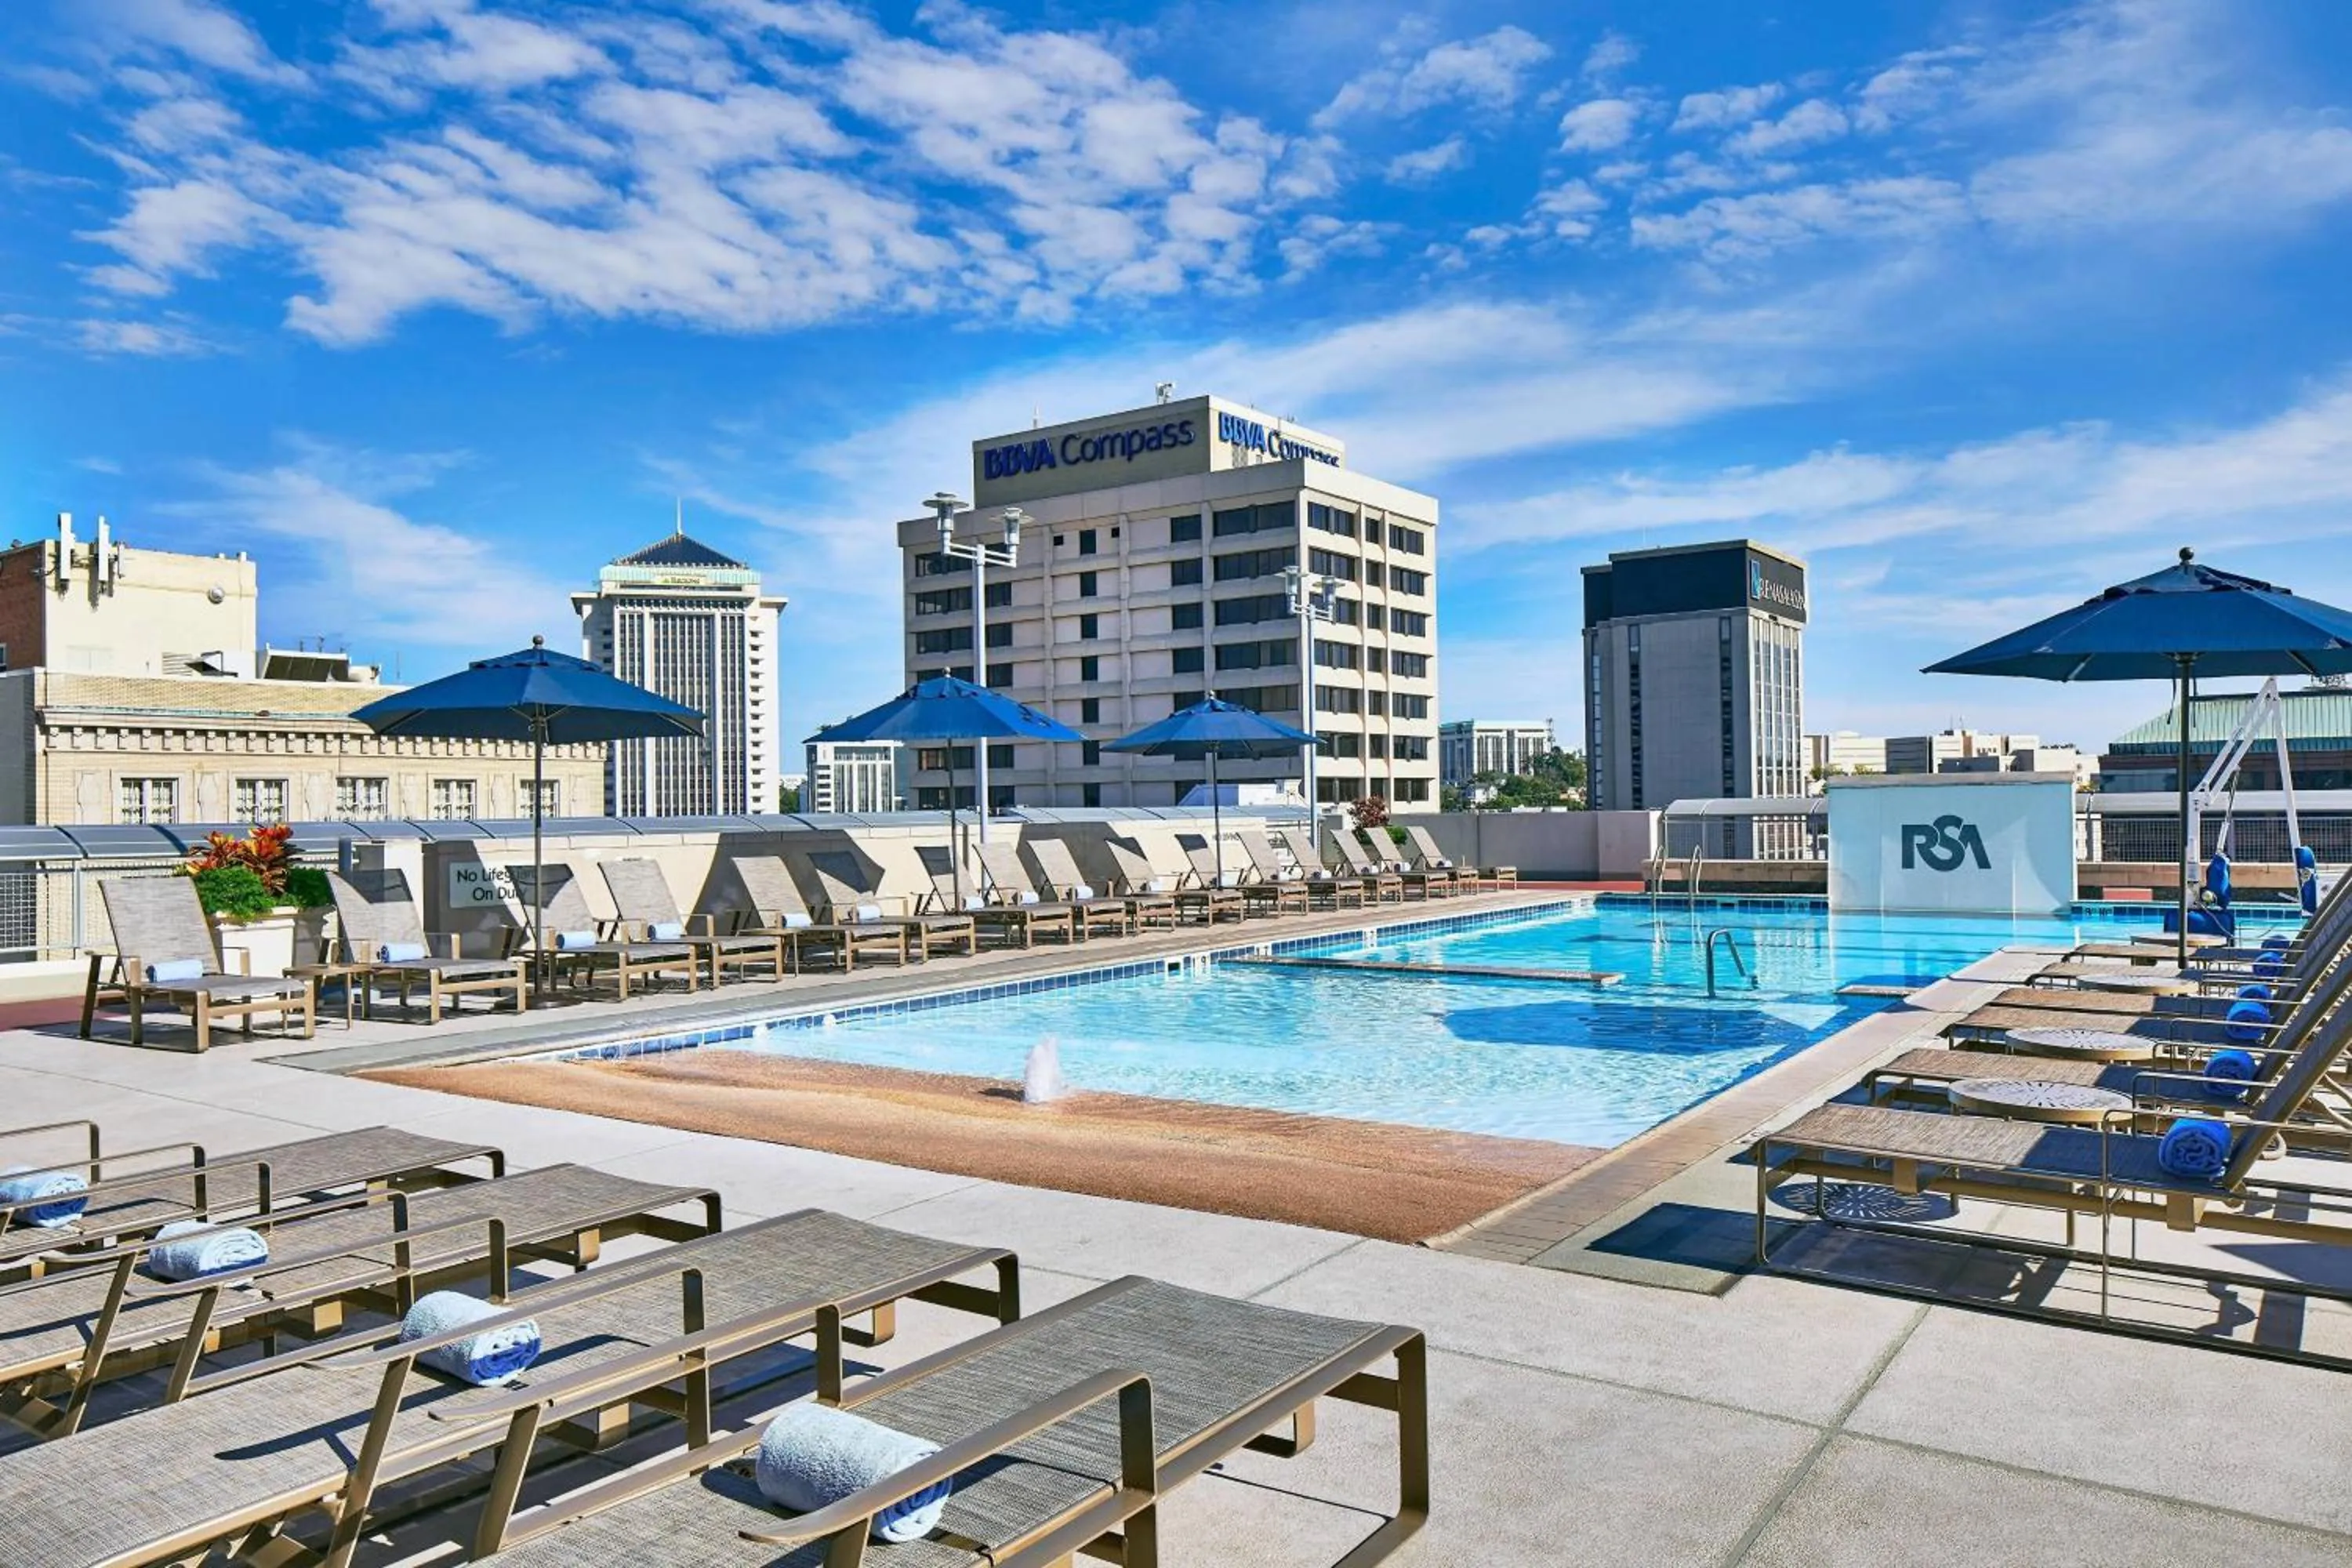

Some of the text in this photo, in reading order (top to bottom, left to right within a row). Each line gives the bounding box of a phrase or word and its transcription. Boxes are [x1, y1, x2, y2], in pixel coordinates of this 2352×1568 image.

[984, 419, 1196, 481] BBVA Compass
[1218, 412, 1267, 455] BBVA
[1901, 814, 1992, 872] RSA
[457, 867, 538, 884] No Lifegar
[473, 886, 528, 902] On Duy
